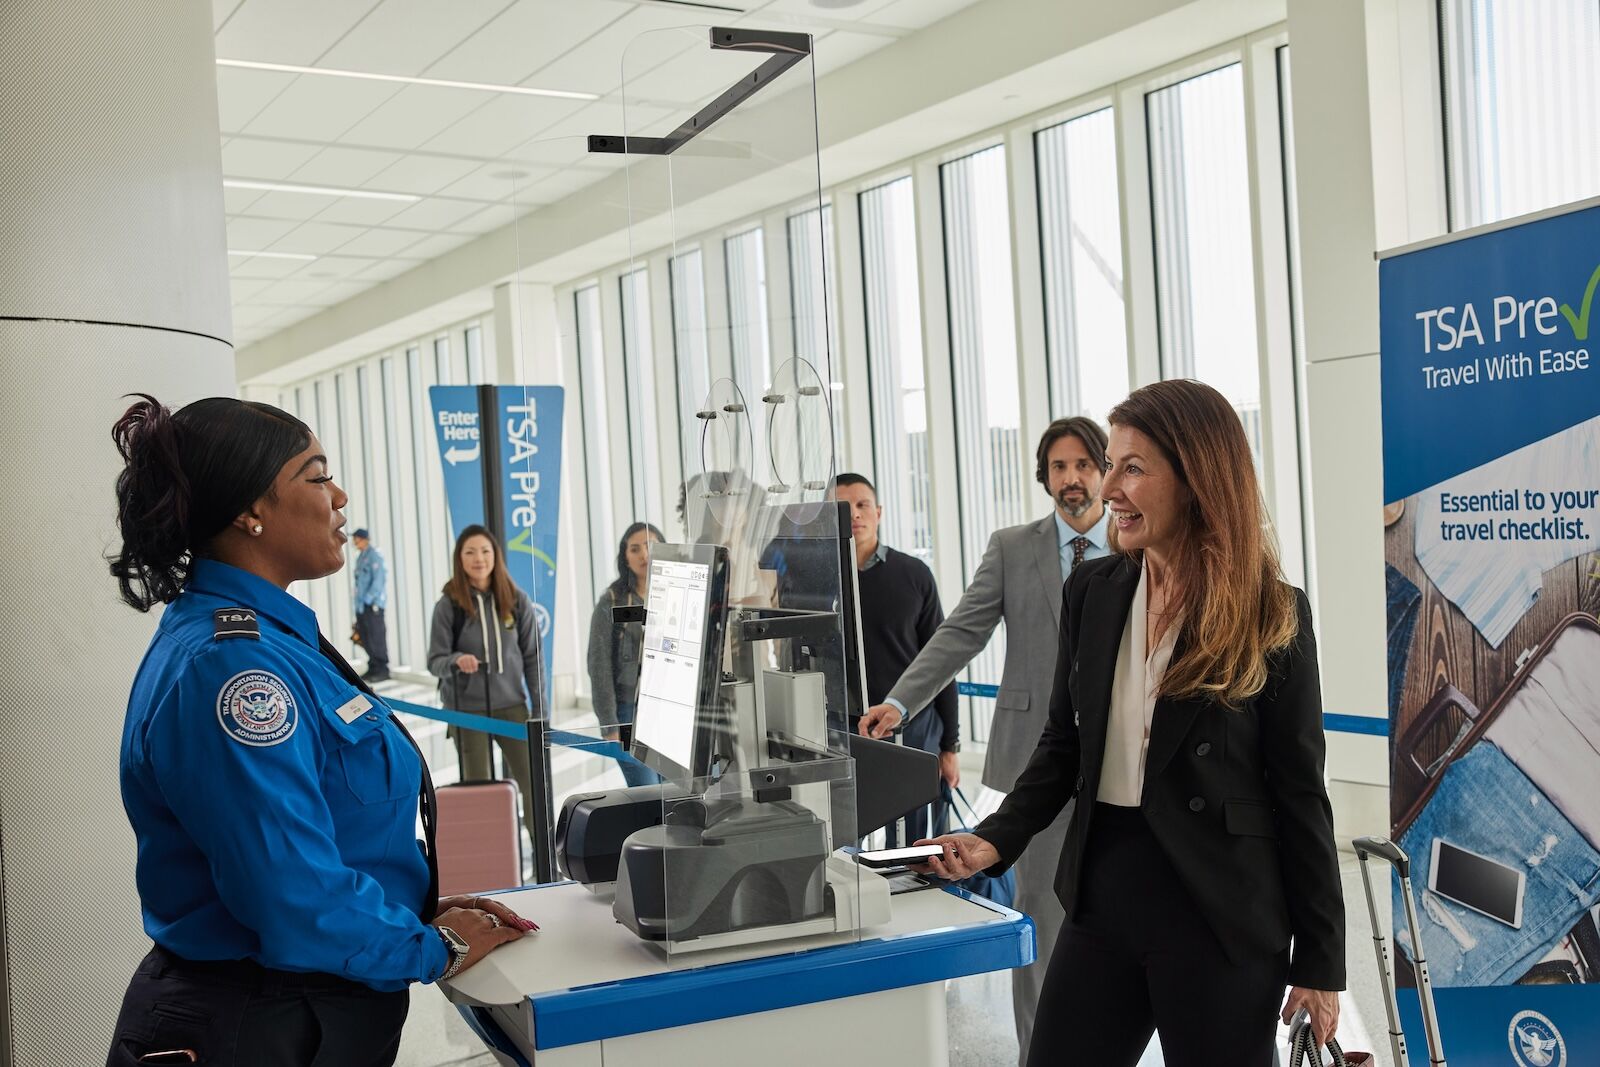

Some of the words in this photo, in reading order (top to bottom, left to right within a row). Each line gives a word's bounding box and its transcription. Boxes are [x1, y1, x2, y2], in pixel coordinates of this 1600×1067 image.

[1415, 303, 1485, 354] TSA
[1493, 295, 1558, 343] Pre
[1422, 358, 1480, 389] Travel
[1485, 351, 1532, 381] With
[1539, 348, 1589, 375] Ease
[438, 411, 479, 426] Enter
[506, 397, 539, 464] TSA
[444, 426, 480, 440] Here
[510, 471, 540, 528] Pre
[1440, 489, 1519, 513] Essential
[1524, 489, 1546, 511] to
[1550, 490, 1599, 514] your
[1440, 519, 1494, 541] travel
[1498, 517, 1590, 540] checklist.
[218, 614, 256, 622] TSA
[223, 674, 268, 716] TRANSPORTATION
[268, 678, 293, 707] SECURITY
[234, 721, 292, 741] ADMINISTRATION
